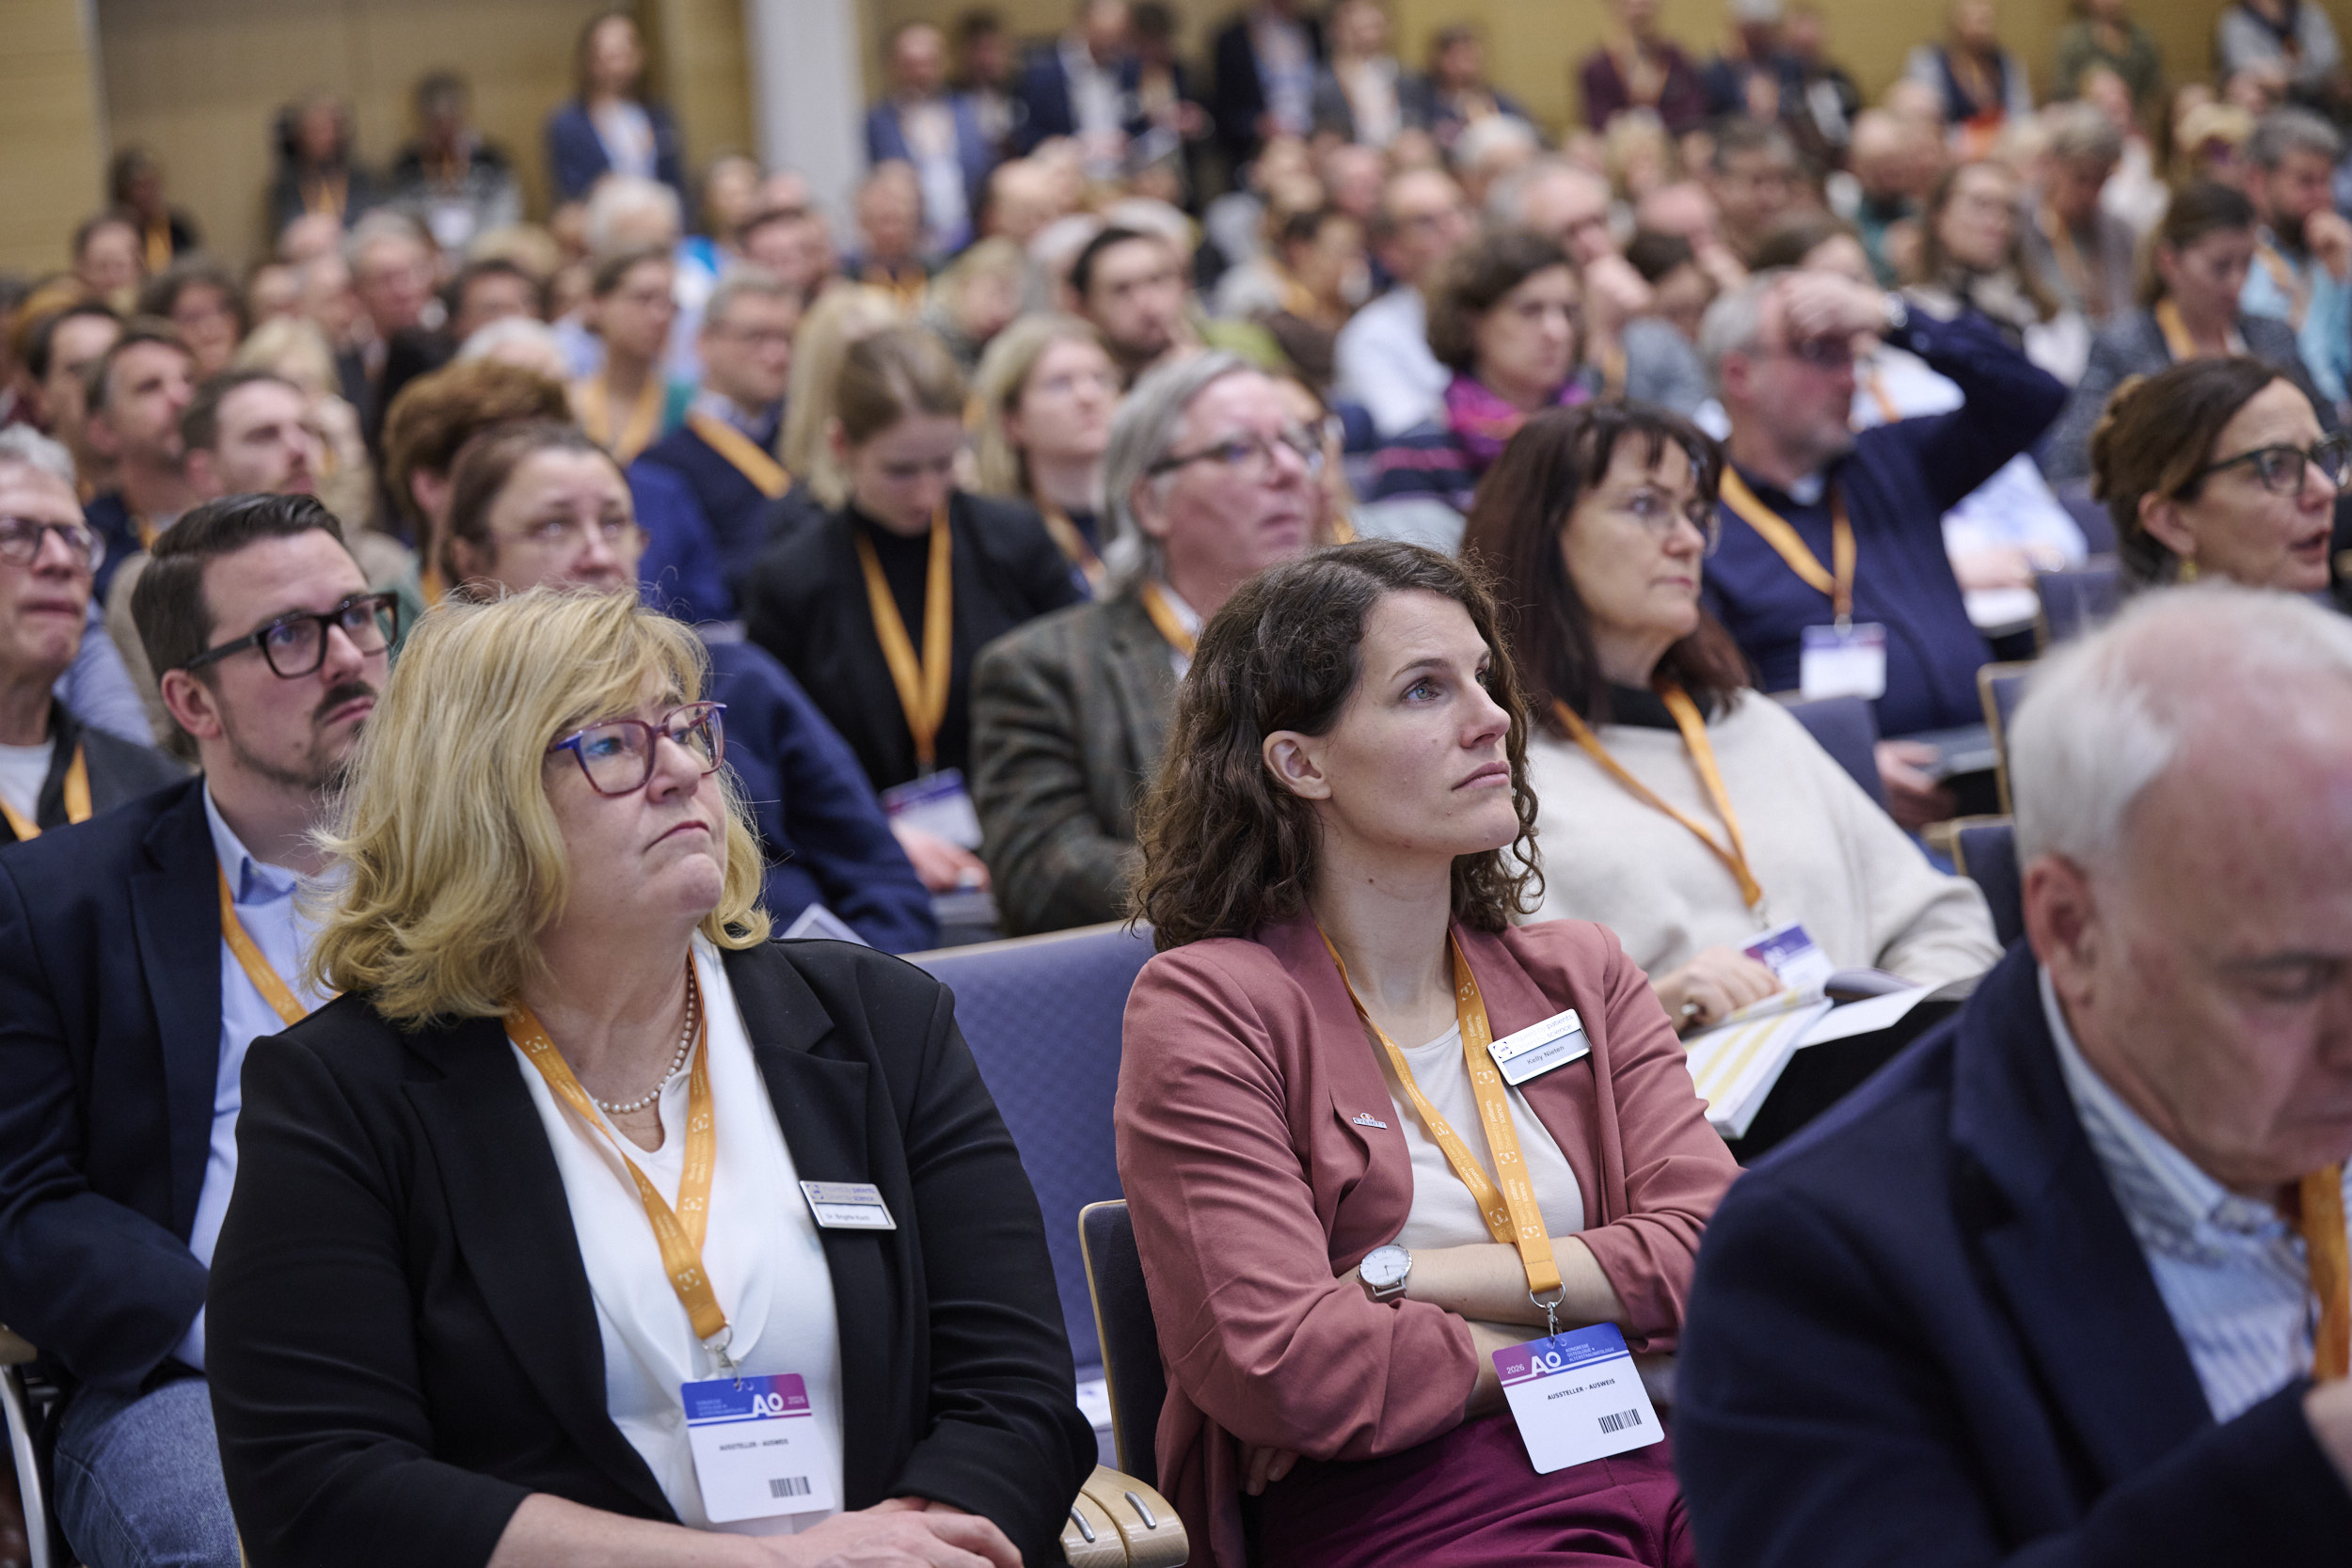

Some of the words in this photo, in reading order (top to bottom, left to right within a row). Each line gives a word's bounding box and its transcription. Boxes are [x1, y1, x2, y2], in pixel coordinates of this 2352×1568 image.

[1526, 1054, 1544, 1065] Kelly
[1544, 1045, 1565, 1058] Nieten
[1506, 1364, 1525, 1374] 2026
[1531, 1351, 1562, 1377] AO
[1548, 1386, 1584, 1400] AUSSTELLER
[1589, 1378, 1615, 1389] AUSWEIS
[753, 1392, 785, 1418] AO
